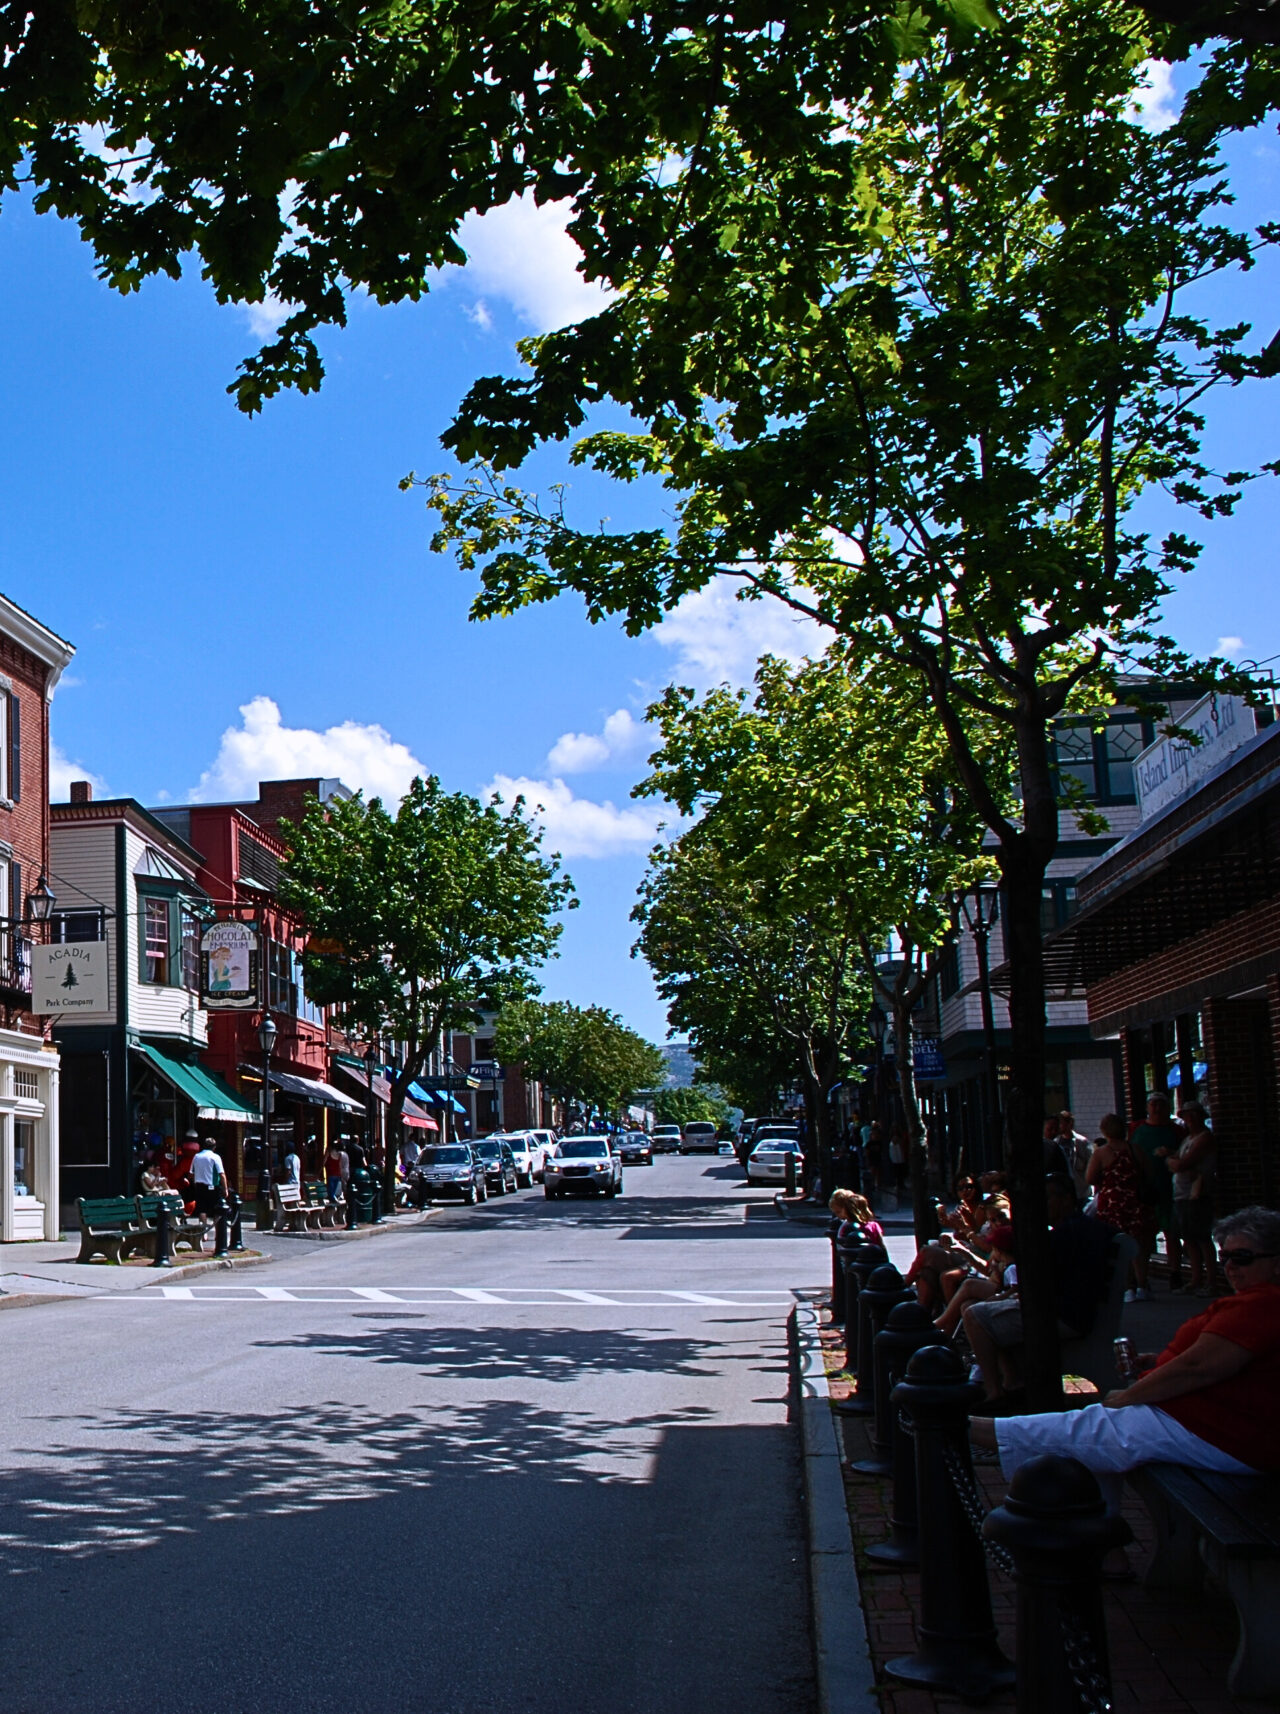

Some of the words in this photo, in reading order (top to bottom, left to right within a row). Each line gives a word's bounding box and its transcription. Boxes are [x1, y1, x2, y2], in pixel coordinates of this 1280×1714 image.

[1139, 743, 1169, 798] Island
[203, 931, 256, 942] HOCOLAT
[48, 947, 91, 964] ACADIA
[45, 998, 61, 1007] Park
[62, 998, 95, 1007] Company
[913, 1038, 938, 1046] NEAST
